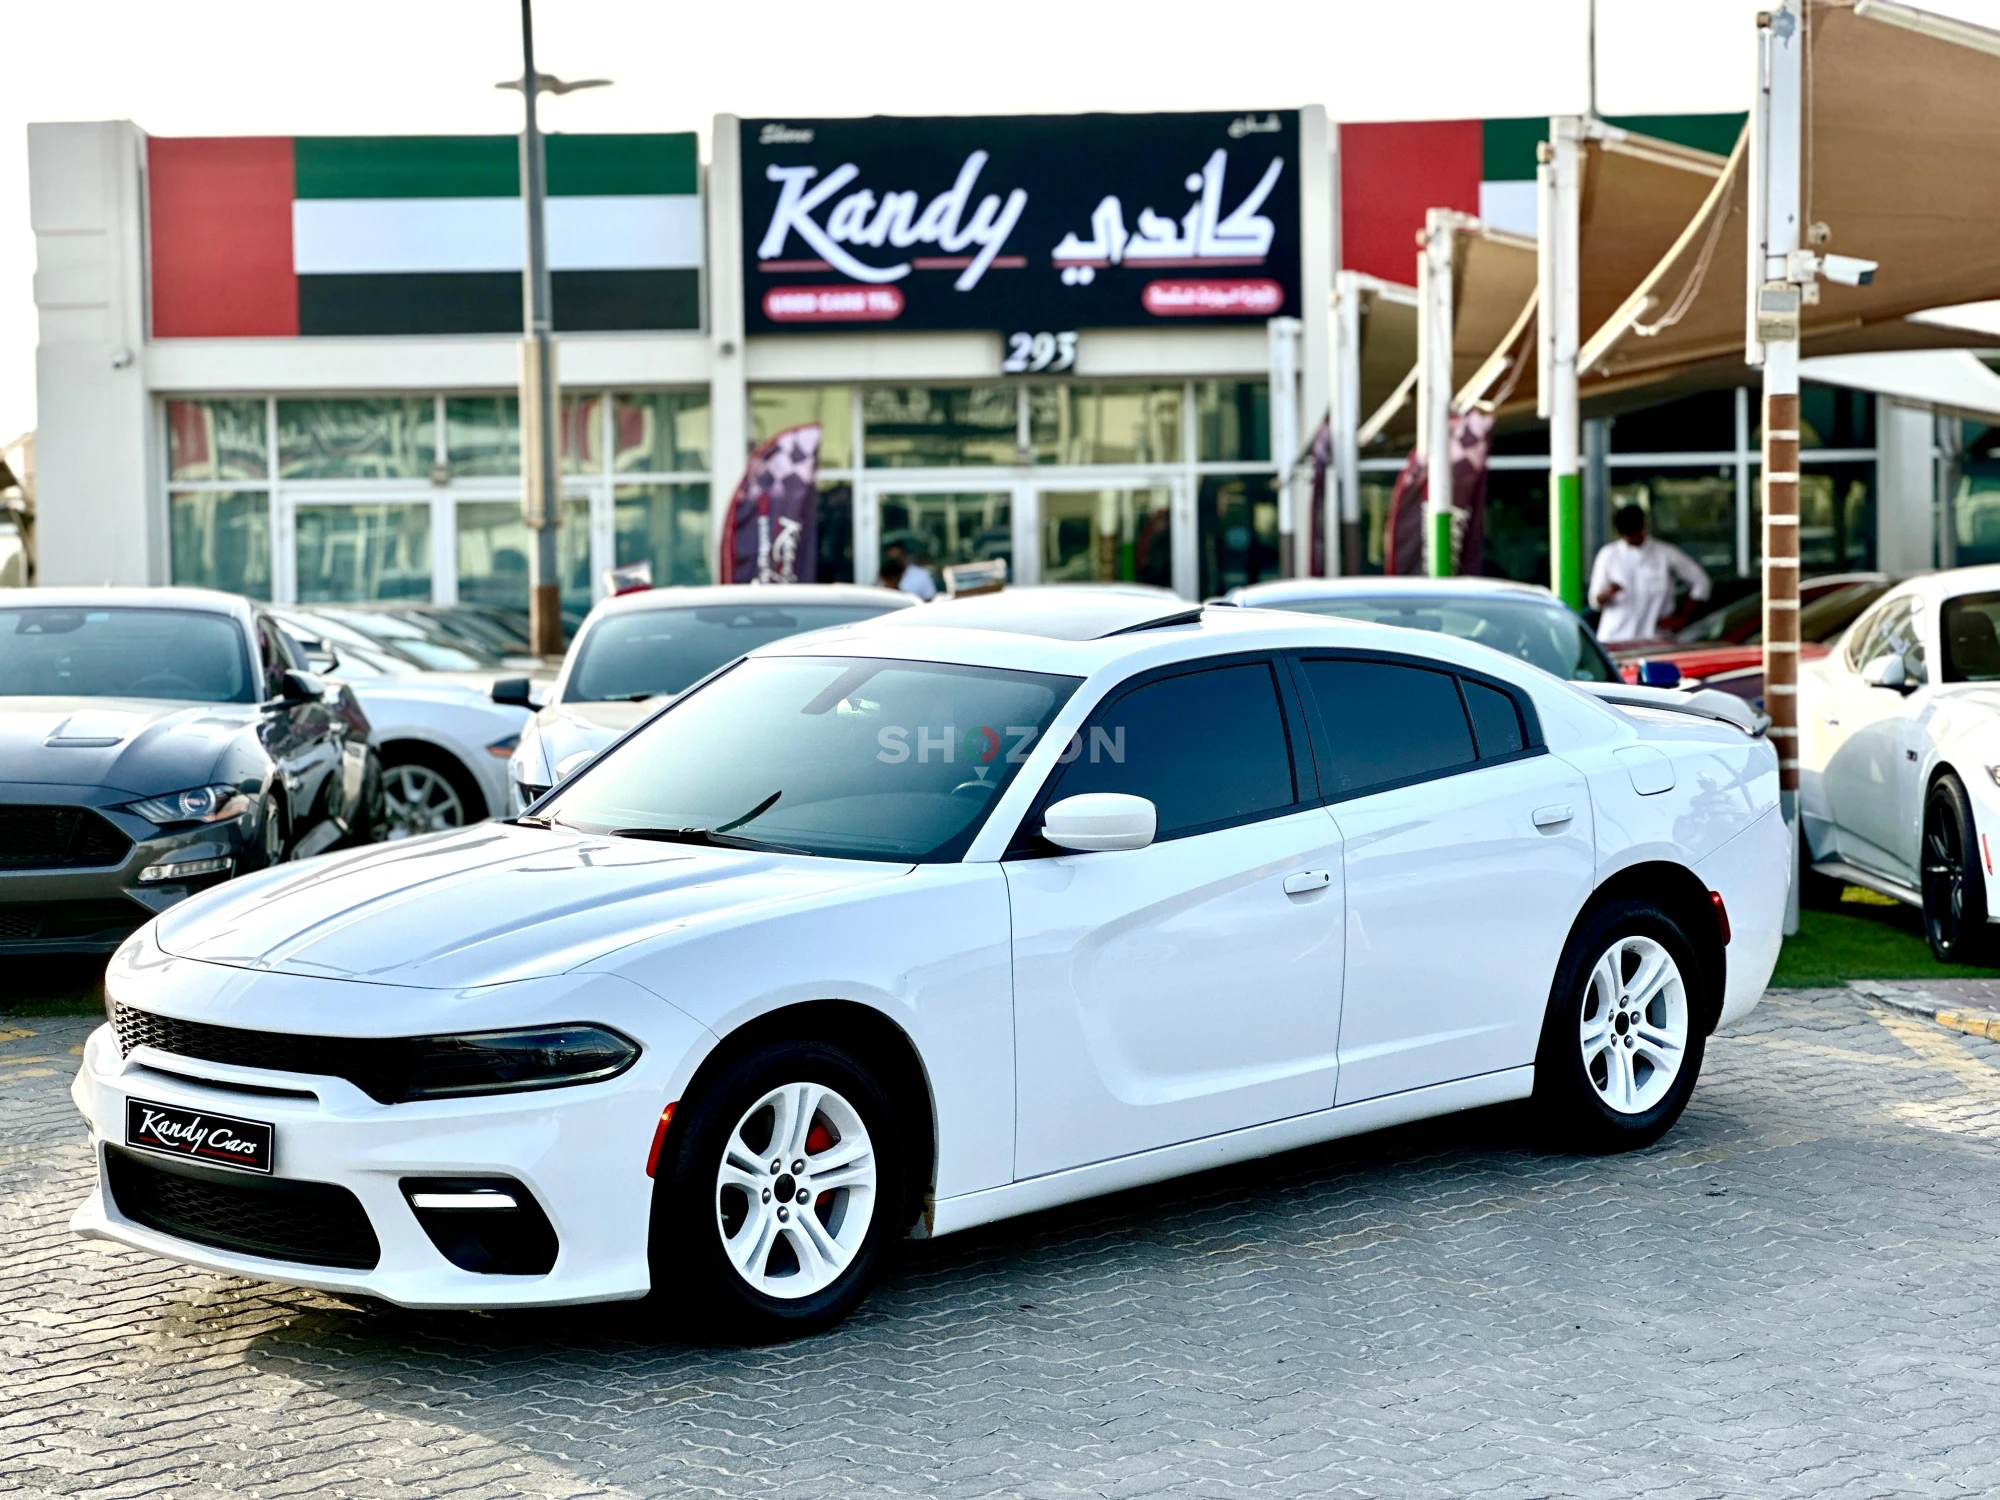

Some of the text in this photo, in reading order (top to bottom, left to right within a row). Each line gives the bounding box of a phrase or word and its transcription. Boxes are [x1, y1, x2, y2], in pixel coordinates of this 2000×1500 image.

[759, 152, 1027, 290] Kandy
[1053, 149, 1283, 285] كاندي
[139, 1109, 258, 1154] Kandy Cars
